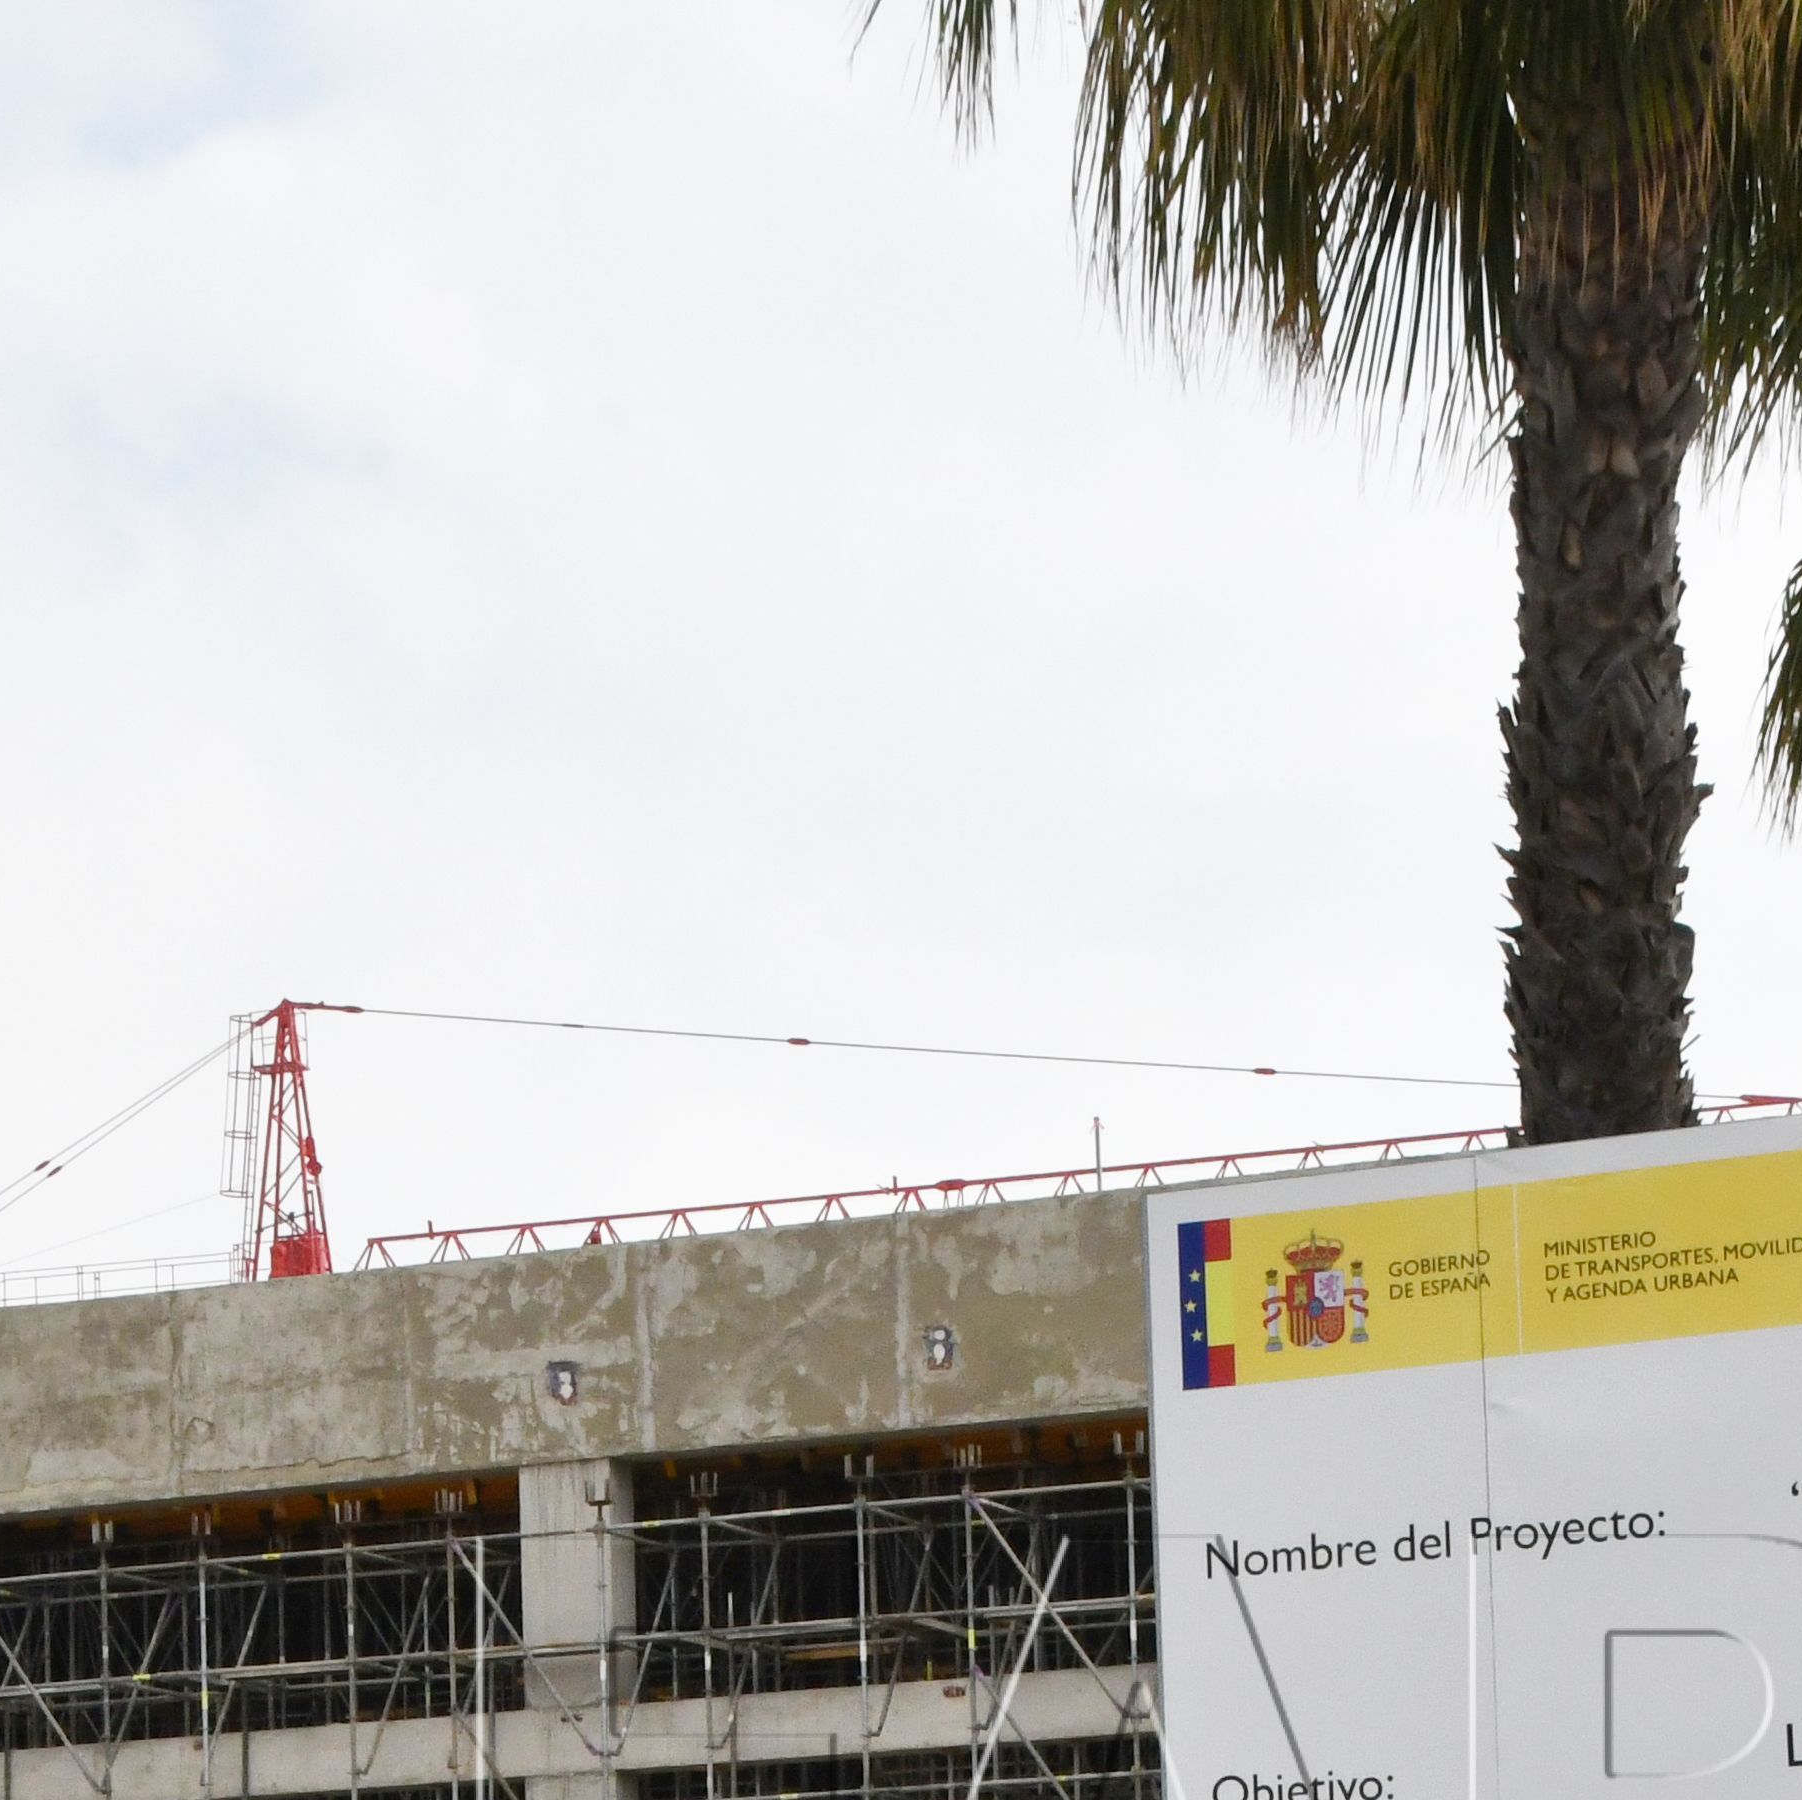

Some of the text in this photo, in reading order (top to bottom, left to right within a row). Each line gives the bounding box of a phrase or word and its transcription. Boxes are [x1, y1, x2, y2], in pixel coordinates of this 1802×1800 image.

[1543, 1231, 1656, 1259] MINISTERIO
[1388, 1249, 1491, 1278] GOBIERNO
[1545, 1264, 1573, 1282] DE
[1576, 1247, 1719, 1277] TRANSPORTES,
[1389, 1271, 1491, 1301] DE ESPAÑA
[1546, 1267, 1739, 1303] Y AGENDA URBANA
[1205, 1510, 1666, 1579] Nombre del Proyecto:
